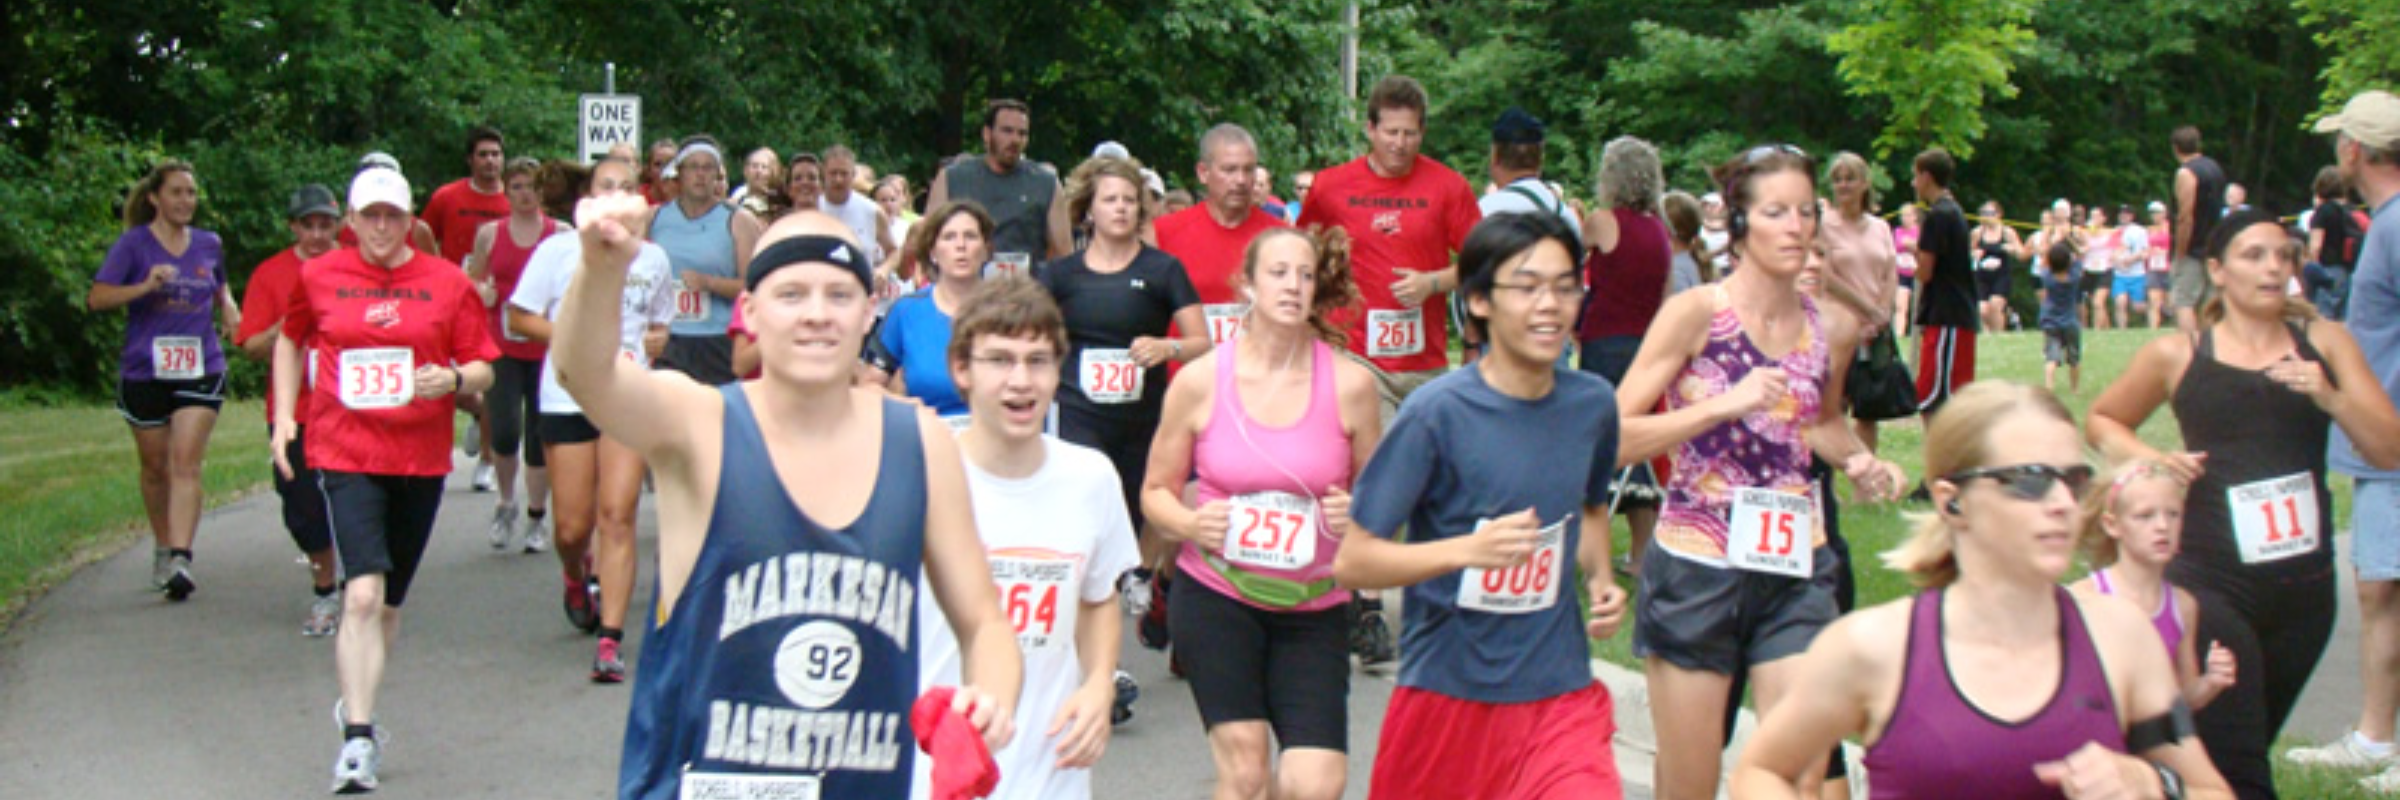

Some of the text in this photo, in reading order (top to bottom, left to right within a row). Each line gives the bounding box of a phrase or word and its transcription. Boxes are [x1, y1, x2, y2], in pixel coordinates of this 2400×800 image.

[590, 102, 633, 121] ONE
[588, 126, 633, 143] WAY
[1348, 196, 1429, 208] SCHEELS
[335, 288, 433, 301] SCHEELS
[676, 289, 702, 314] 01
[1213, 316, 1240, 343] 17
[1376, 321, 1417, 347] 261
[161, 347, 197, 371] 379
[352, 363, 404, 395] 335
[1091, 363, 1136, 392] 320
[1239, 507, 1305, 554] 257
[2260, 495, 2304, 542] 11
[1756, 510, 1795, 556] 15
[996, 583, 1058, 635] 64
[807, 645, 853, 681] 92
[704, 700, 901, 772] BASKETBALL
